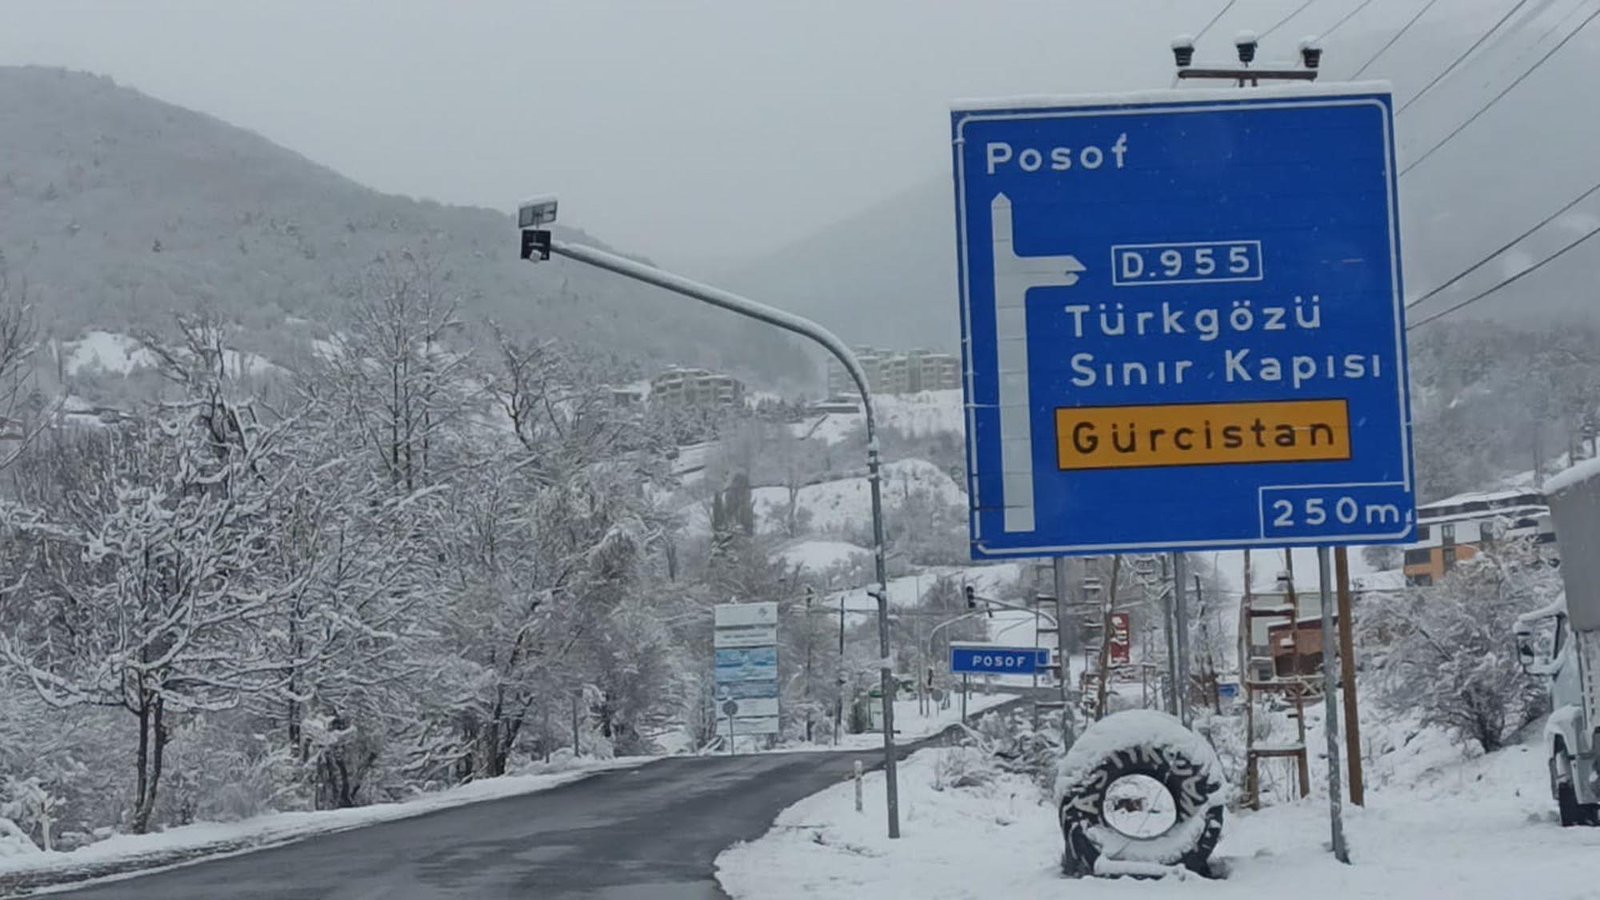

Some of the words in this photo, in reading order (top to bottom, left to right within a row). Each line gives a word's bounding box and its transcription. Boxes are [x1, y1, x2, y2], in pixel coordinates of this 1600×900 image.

[986, 133, 1128, 174] Posof
[1122, 247, 1250, 279] D.955
[1065, 295, 1321, 342] Türkgözü
[1071, 353, 1193, 387] Sınır
[1225, 349, 1381, 388] Kapısı
[1072, 417, 1335, 455] Gürcistan
[972, 655, 1026, 667] POSOF
